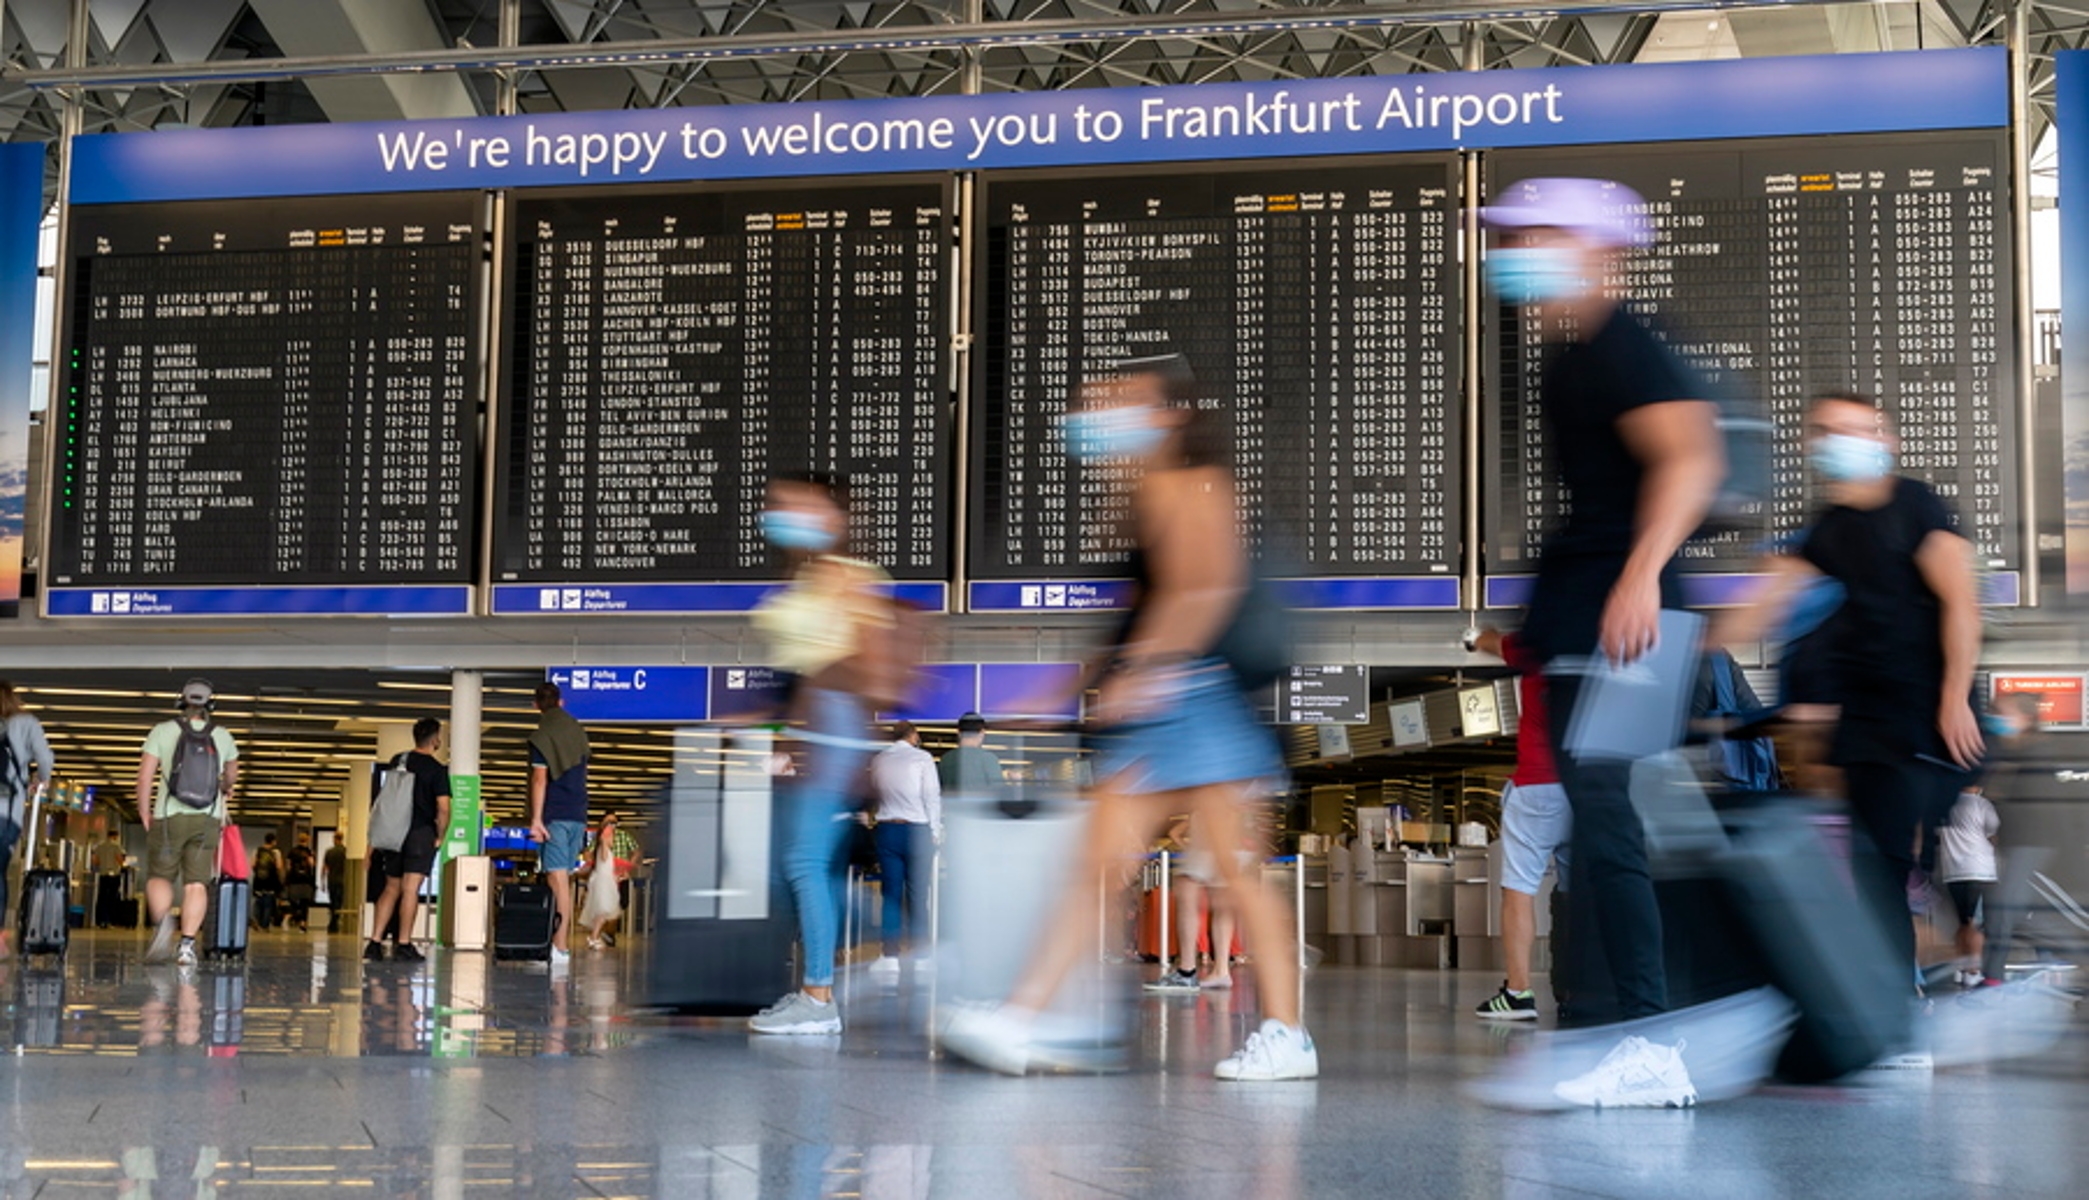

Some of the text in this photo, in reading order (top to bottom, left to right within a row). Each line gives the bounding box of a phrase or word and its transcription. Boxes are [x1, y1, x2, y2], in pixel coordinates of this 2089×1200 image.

[378, 83, 1563, 176] We're happy to welcome you to Frankfurt Airport
[1014, 227, 1027, 238] LH
[1013, 241, 1027, 251] LH
[1013, 254, 1027, 265] LH
[1012, 267, 1026, 278] LH
[1012, 281, 1026, 292] LH
[1012, 294, 1026, 305] LH
[1009, 458, 1024, 468] LH
[1009, 485, 1023, 495] LH
[1007, 554, 1022, 565] LH
[633, 670, 647, 690] C
